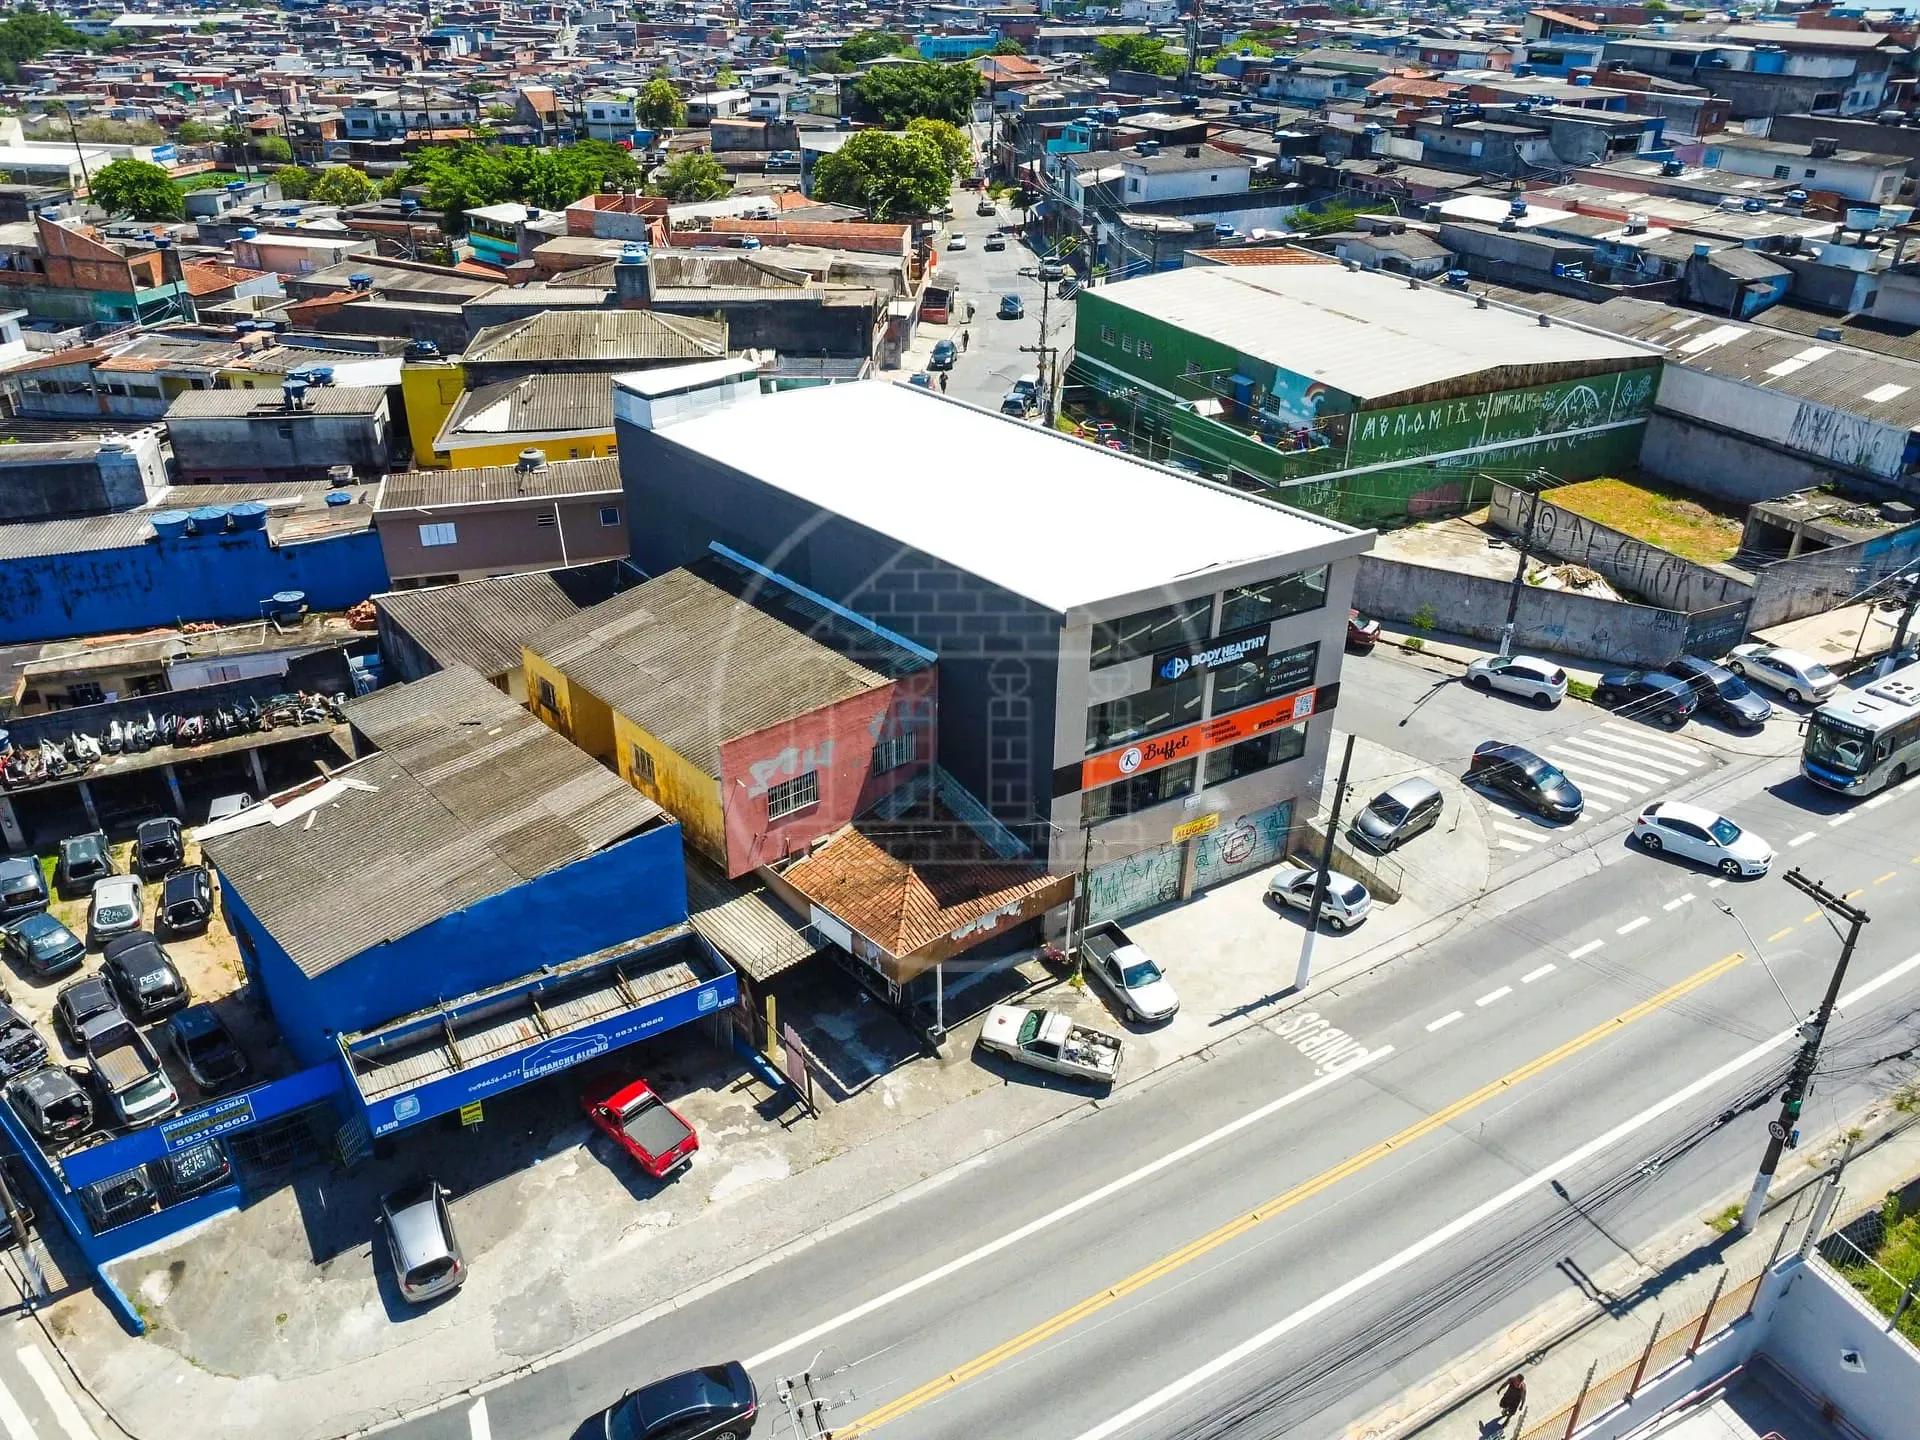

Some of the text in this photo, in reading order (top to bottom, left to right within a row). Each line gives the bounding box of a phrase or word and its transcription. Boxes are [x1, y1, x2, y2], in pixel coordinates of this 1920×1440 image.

[1191, 635, 1266, 667] BODY HEALTHY
[1144, 735, 1189, 760] Buffet
[1175, 819, 1217, 840] ALUGA-SE
[523, 1056, 576, 1080] DESMANCHE
[163, 1111, 210, 1133] DESMANCHE
[176, 1114, 249, 1146] 5931-9660
